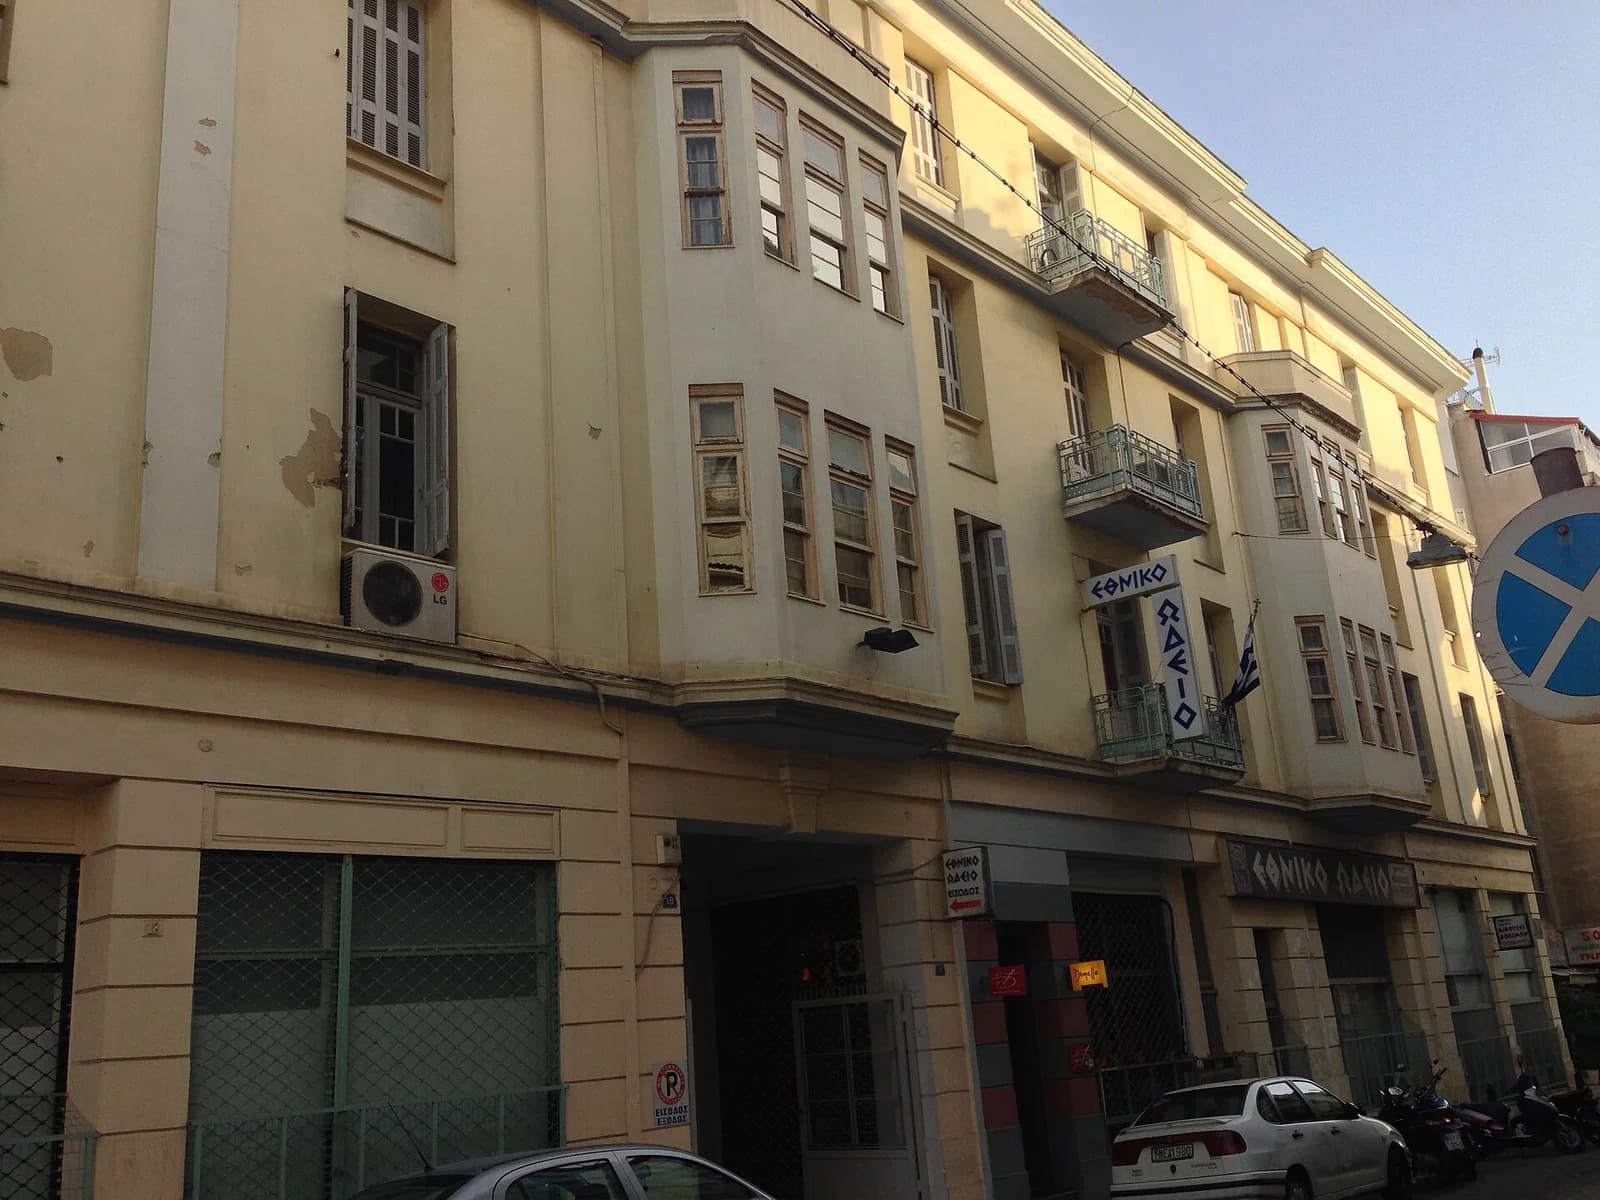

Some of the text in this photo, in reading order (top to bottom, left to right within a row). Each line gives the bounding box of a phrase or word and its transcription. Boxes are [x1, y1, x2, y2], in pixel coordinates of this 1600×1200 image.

[1091, 563, 1168, 599] ΕΘΝΙΚΟ
[433, 594, 448, 605] LG
[1157, 598, 1197, 730] ΩΔΕΙΟ
[945, 856, 979, 870] ΕΘΝΙΚΟ
[946, 870, 978, 884] ΩΔΕΙΟ
[1252, 850, 1328, 895] ΕΘΝΙΚΟ
[656, 1105, 689, 1117] ΕΙΣΟΔΟΣ
[657, 1115, 687, 1126] ΕΞΟΔΟΣ
